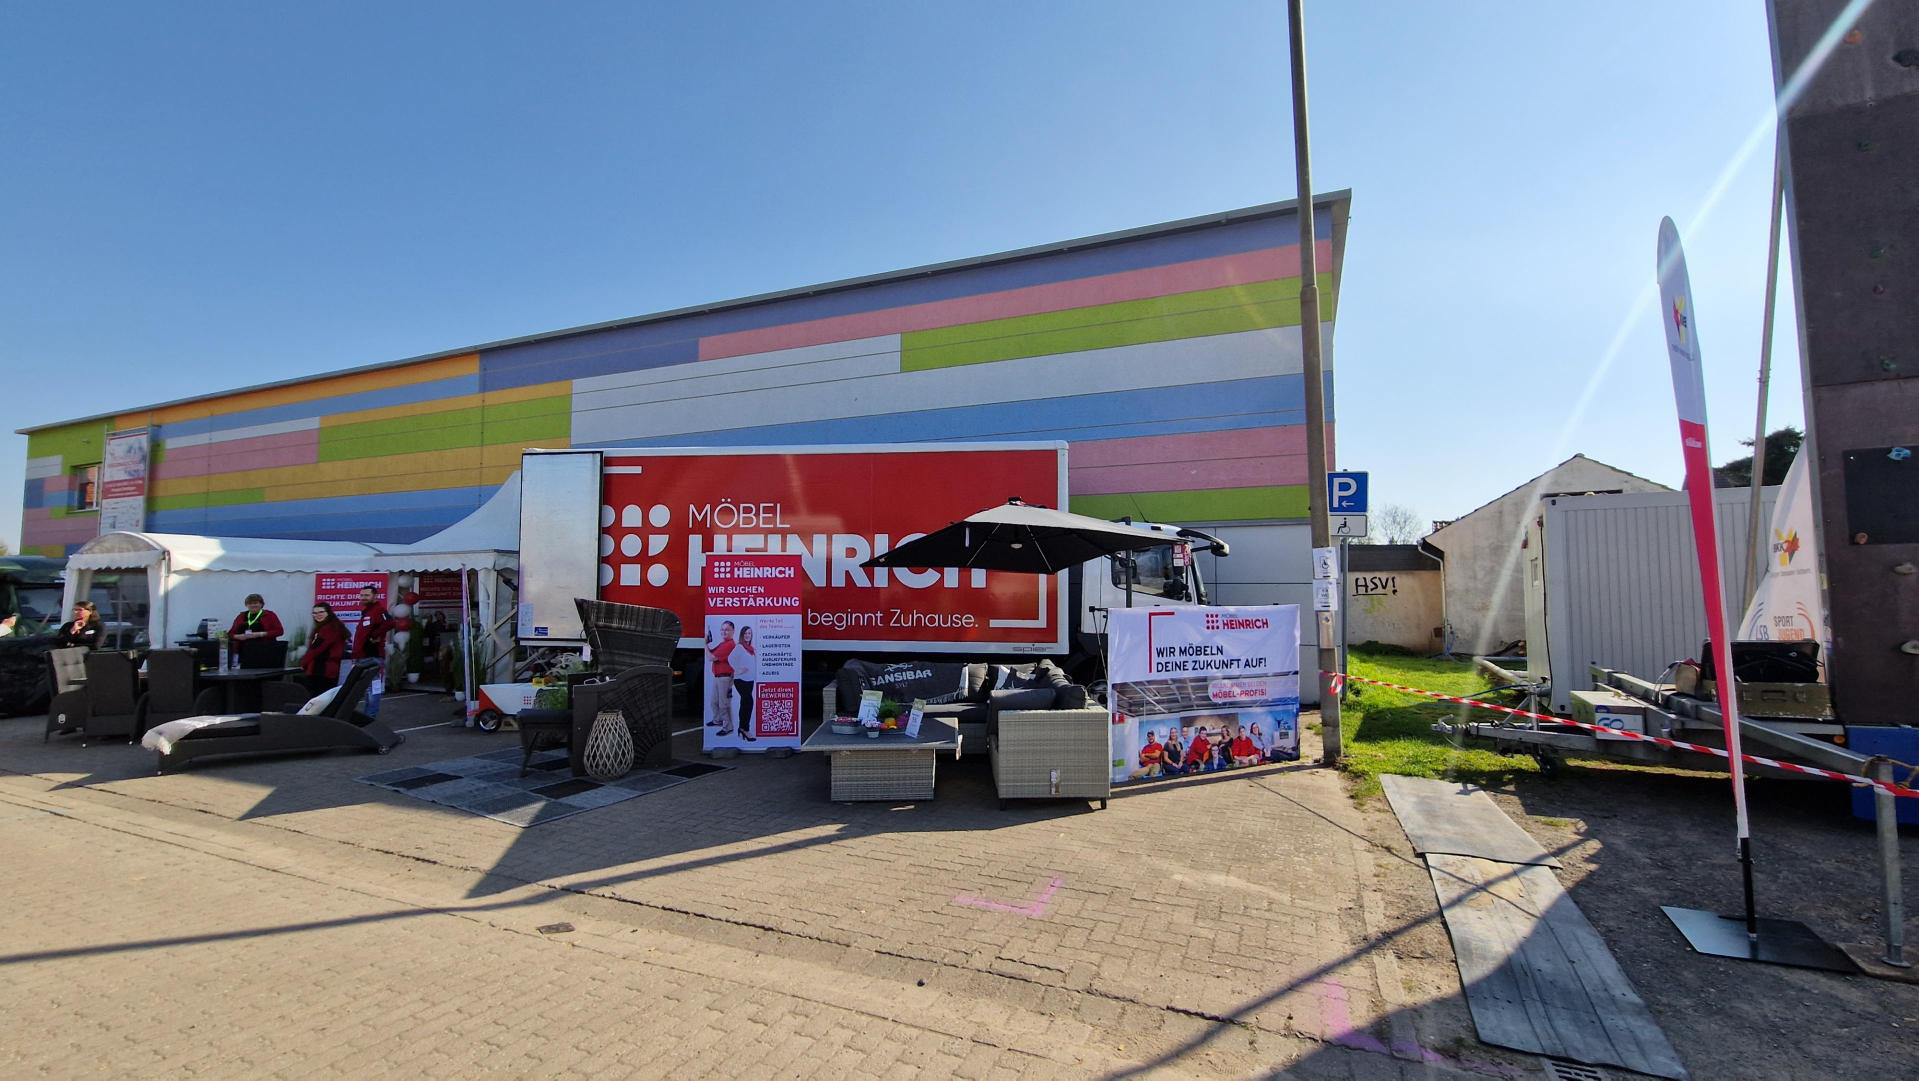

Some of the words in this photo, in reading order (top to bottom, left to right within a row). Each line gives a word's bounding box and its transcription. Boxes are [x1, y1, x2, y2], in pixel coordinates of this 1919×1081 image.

[1332, 477, 1357, 508] P
[688, 497, 791, 529] MÖBEL
[733, 566, 795, 578] HEINRICH
[707, 586, 725, 594] WIR
[727, 586, 765, 594] SUCHEN
[1354, 576, 1398, 595] HSV!
[708, 594, 800, 607] VERSTÄRKUNG
[807, 609, 885, 632] beginnt
[889, 609, 979, 628] Zuhause.
[1222, 618, 1269, 630] HEINRICH
[1773, 615, 1794, 627] SPORT
[1155, 646, 1176, 658] WIR
[1178, 643, 1224, 657] MÖBELN
[1156, 660, 1189, 673] DEINE
[1191, 659, 1242, 671] ZUKUNFT
[1243, 657, 1267, 668] AUF!
